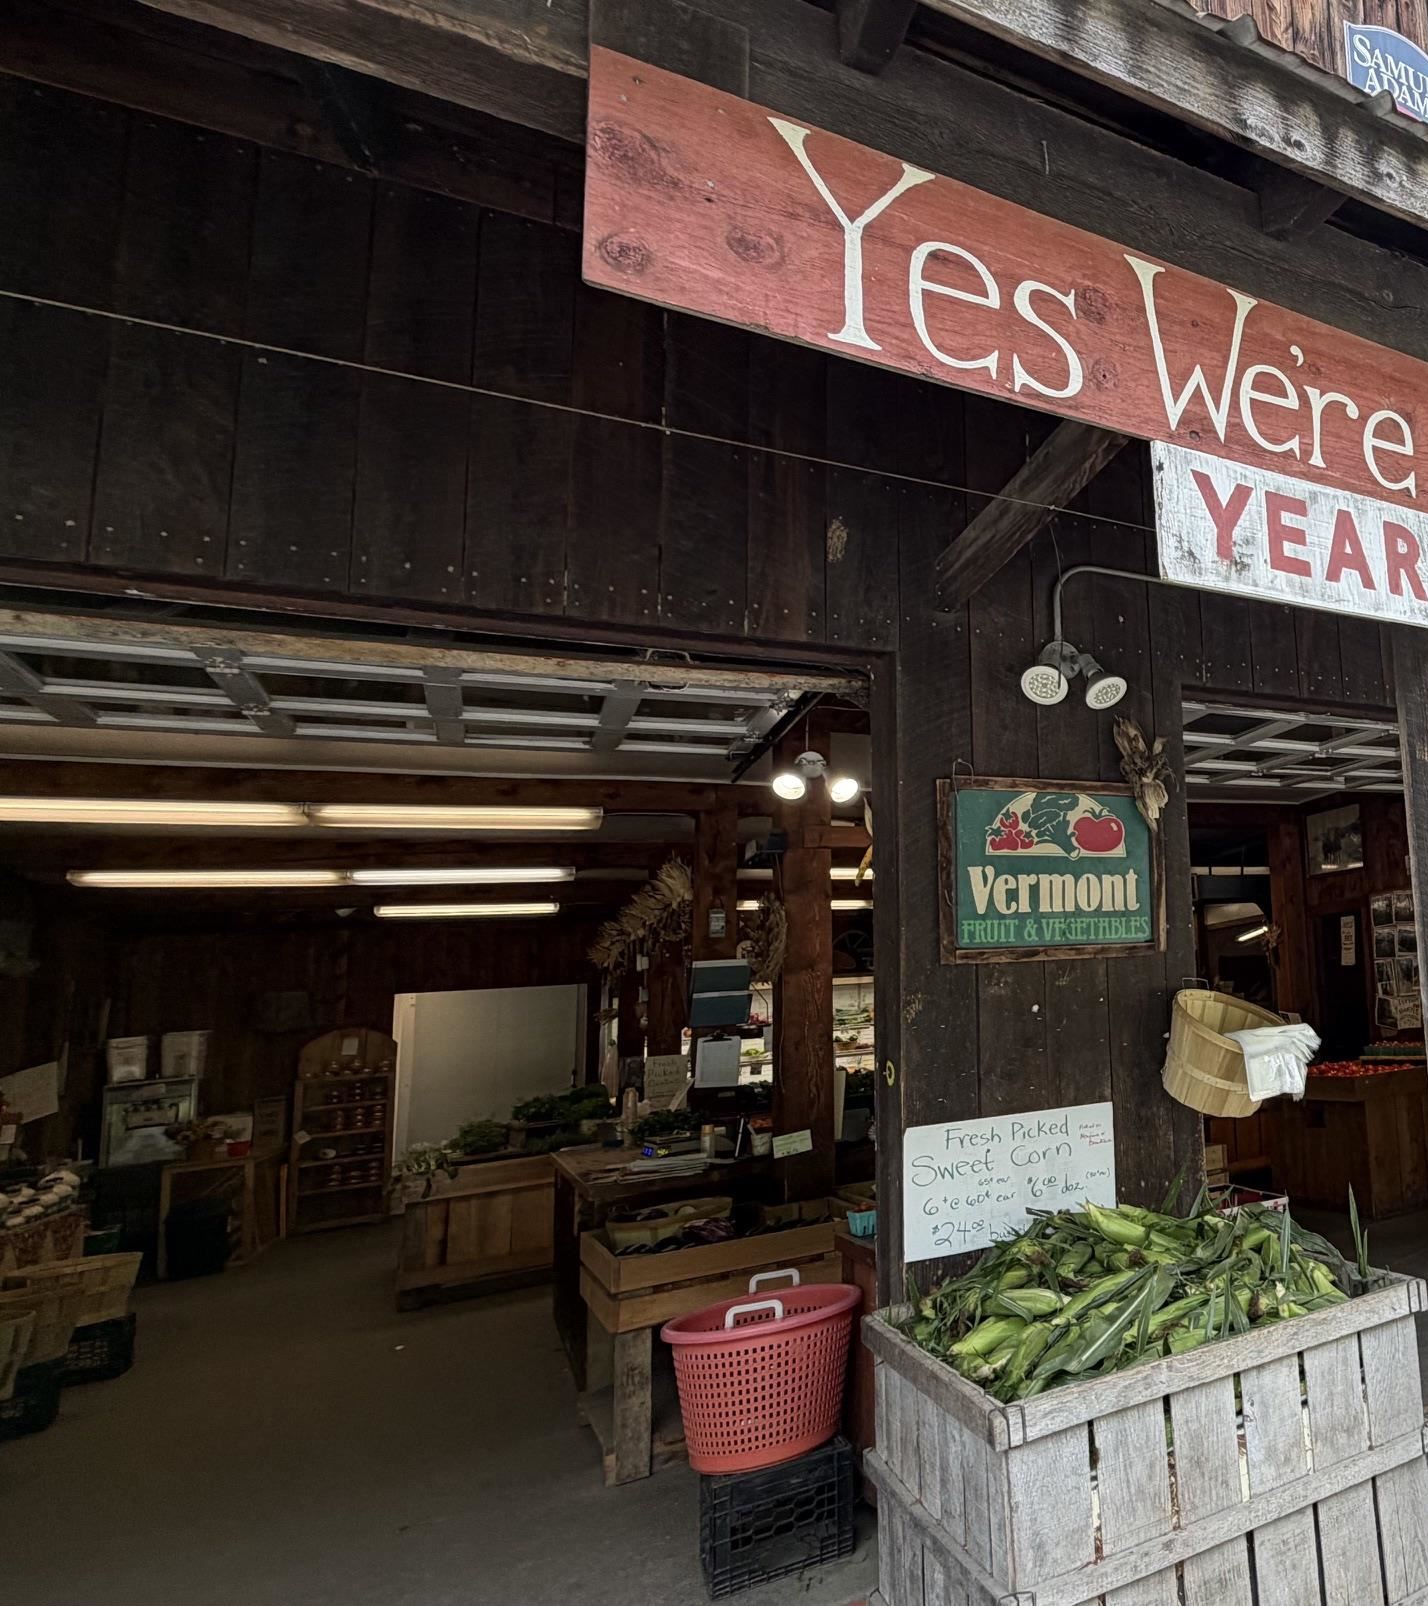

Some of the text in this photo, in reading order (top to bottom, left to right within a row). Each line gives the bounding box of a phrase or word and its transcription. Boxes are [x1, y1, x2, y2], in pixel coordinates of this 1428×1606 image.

[767, 116, 1083, 398] Yes
[1123, 254, 1416, 498] We're
[967, 865, 1140, 915] Vermont
[961, 916, 1150, 944] FRUIT & VEGETABLES
[945, 1114, 1069, 1150] Fresh Picked
[911, 1141, 1072, 1187] Sweet Corn
[996, 1191, 1016, 1202] ear
